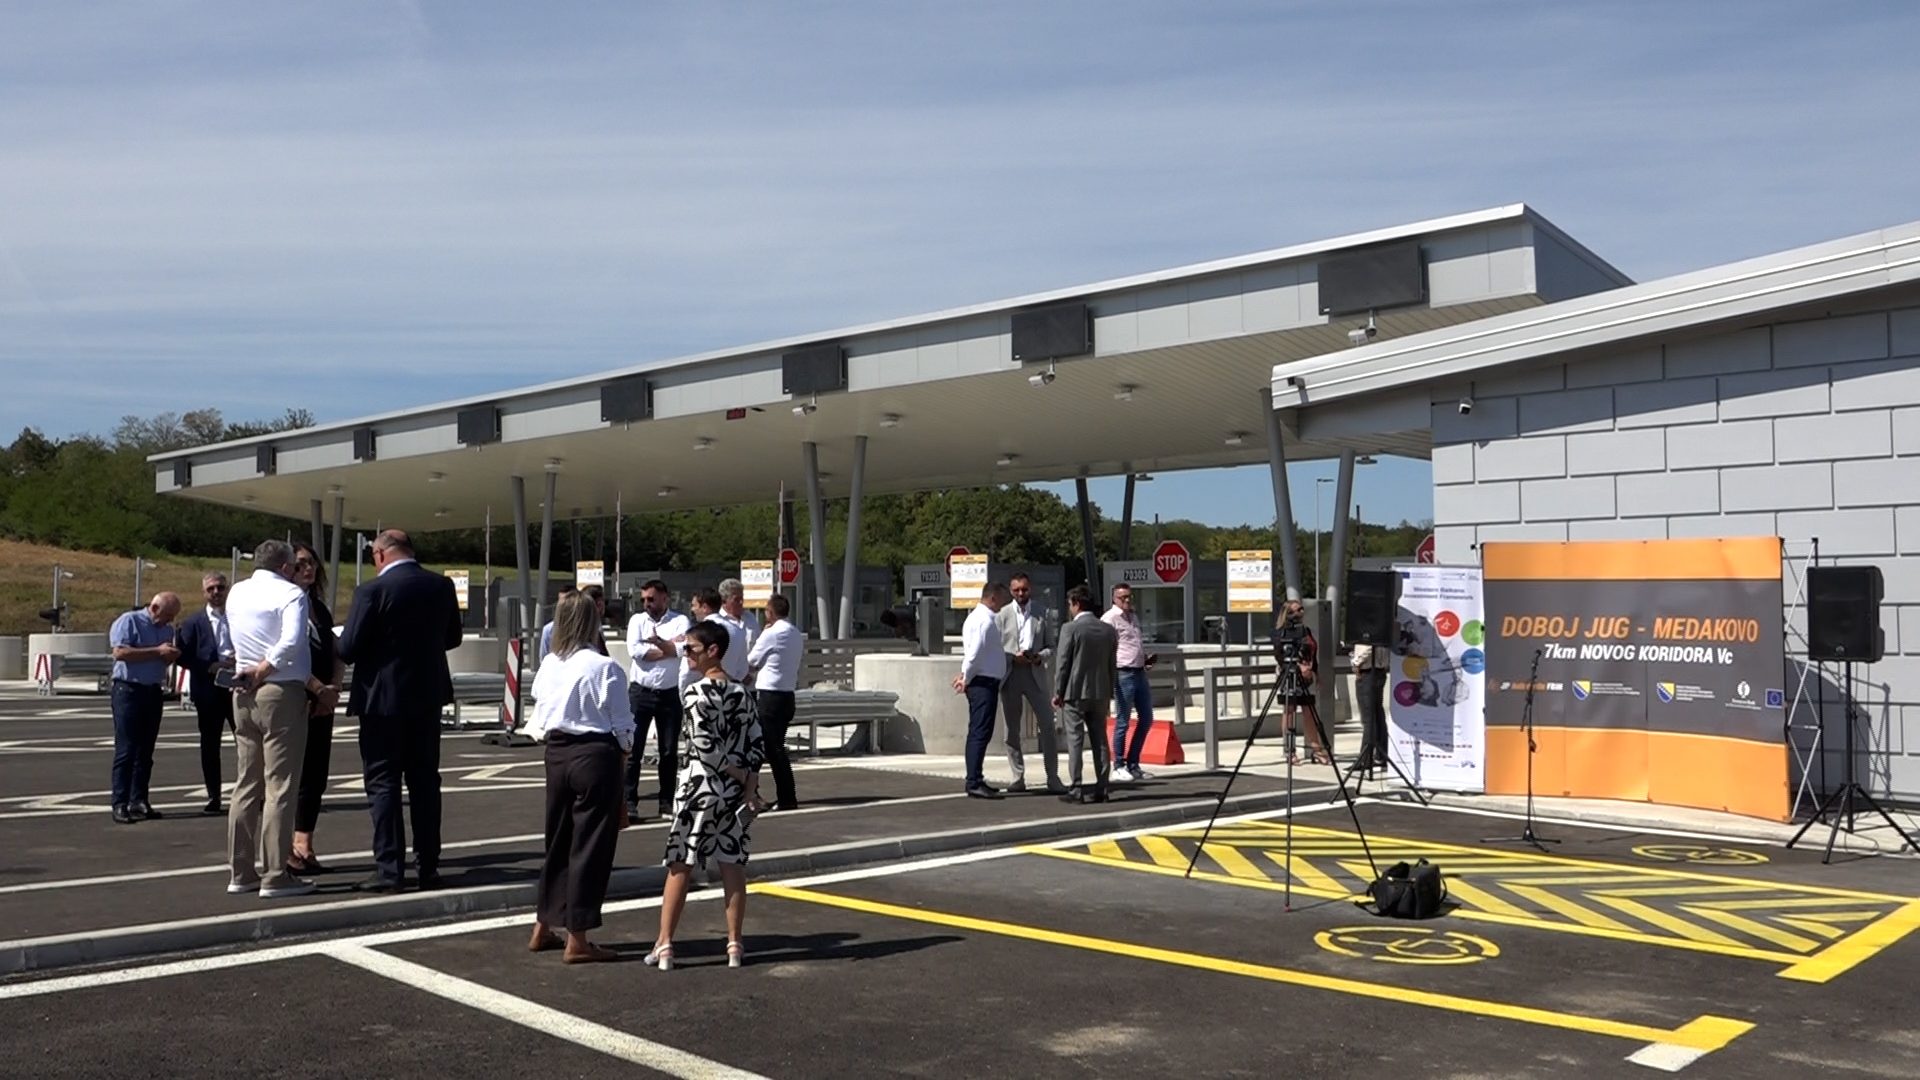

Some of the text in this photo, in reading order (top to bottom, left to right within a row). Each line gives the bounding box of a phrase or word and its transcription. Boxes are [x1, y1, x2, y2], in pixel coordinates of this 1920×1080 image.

[1157, 554, 1185, 571] STOP
[1501, 616, 1580, 638] DOBOJ
[1584, 617, 1630, 639] JUG
[1653, 617, 1759, 643] MEDAKOVO
[1544, 643, 1734, 665] 7km NOVOG KORIDORA Vc
